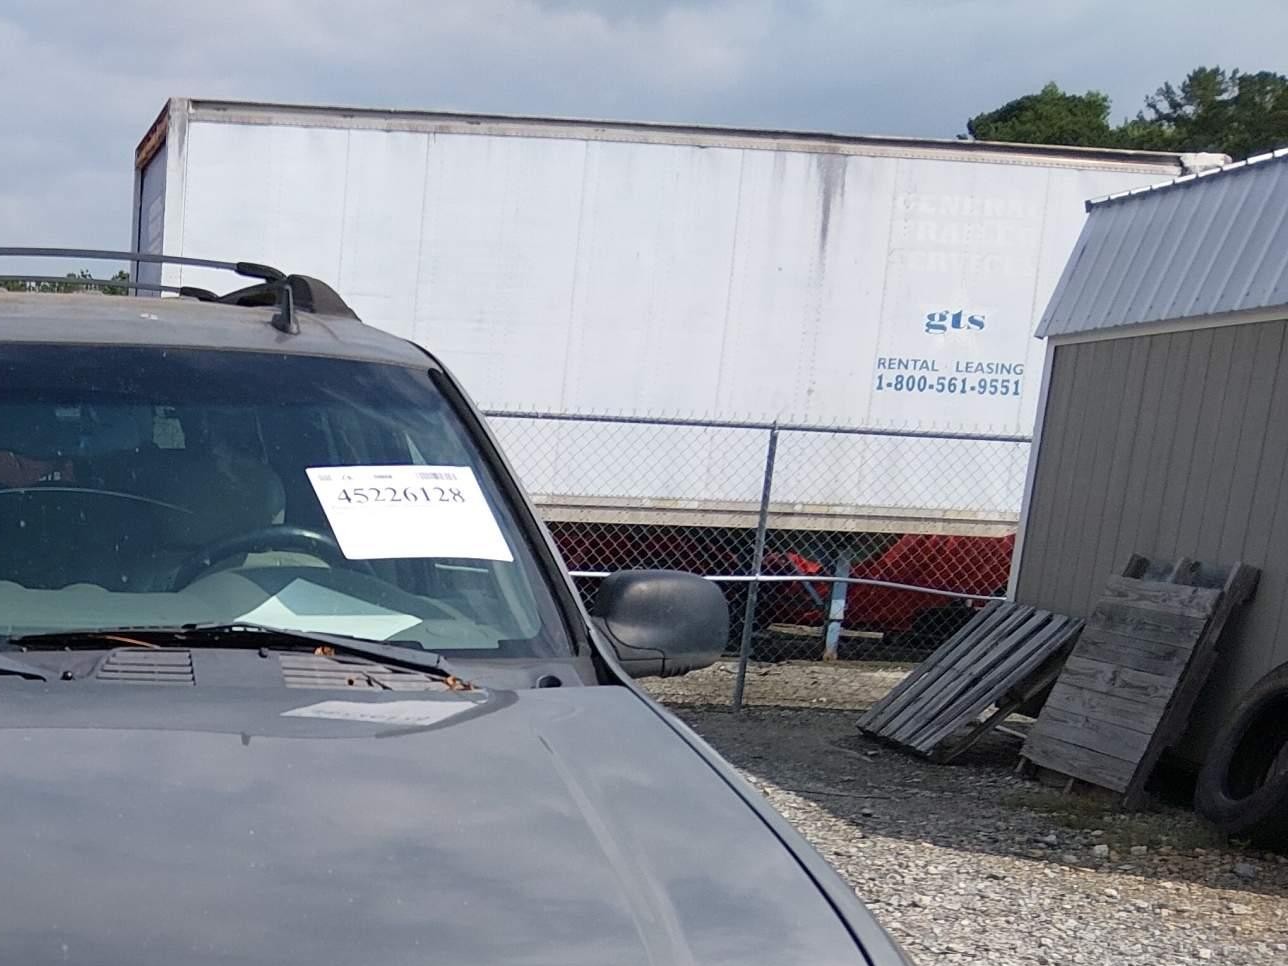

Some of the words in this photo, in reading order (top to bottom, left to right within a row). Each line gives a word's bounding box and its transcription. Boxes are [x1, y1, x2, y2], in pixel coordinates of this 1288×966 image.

[924, 309, 986, 335] gts
[877, 357, 940, 372] RENTAL
[955, 360, 1025, 375] LEASING
[876, 374, 1021, 396] 1-800-561-9551
[337, 486, 467, 504] 45226128
